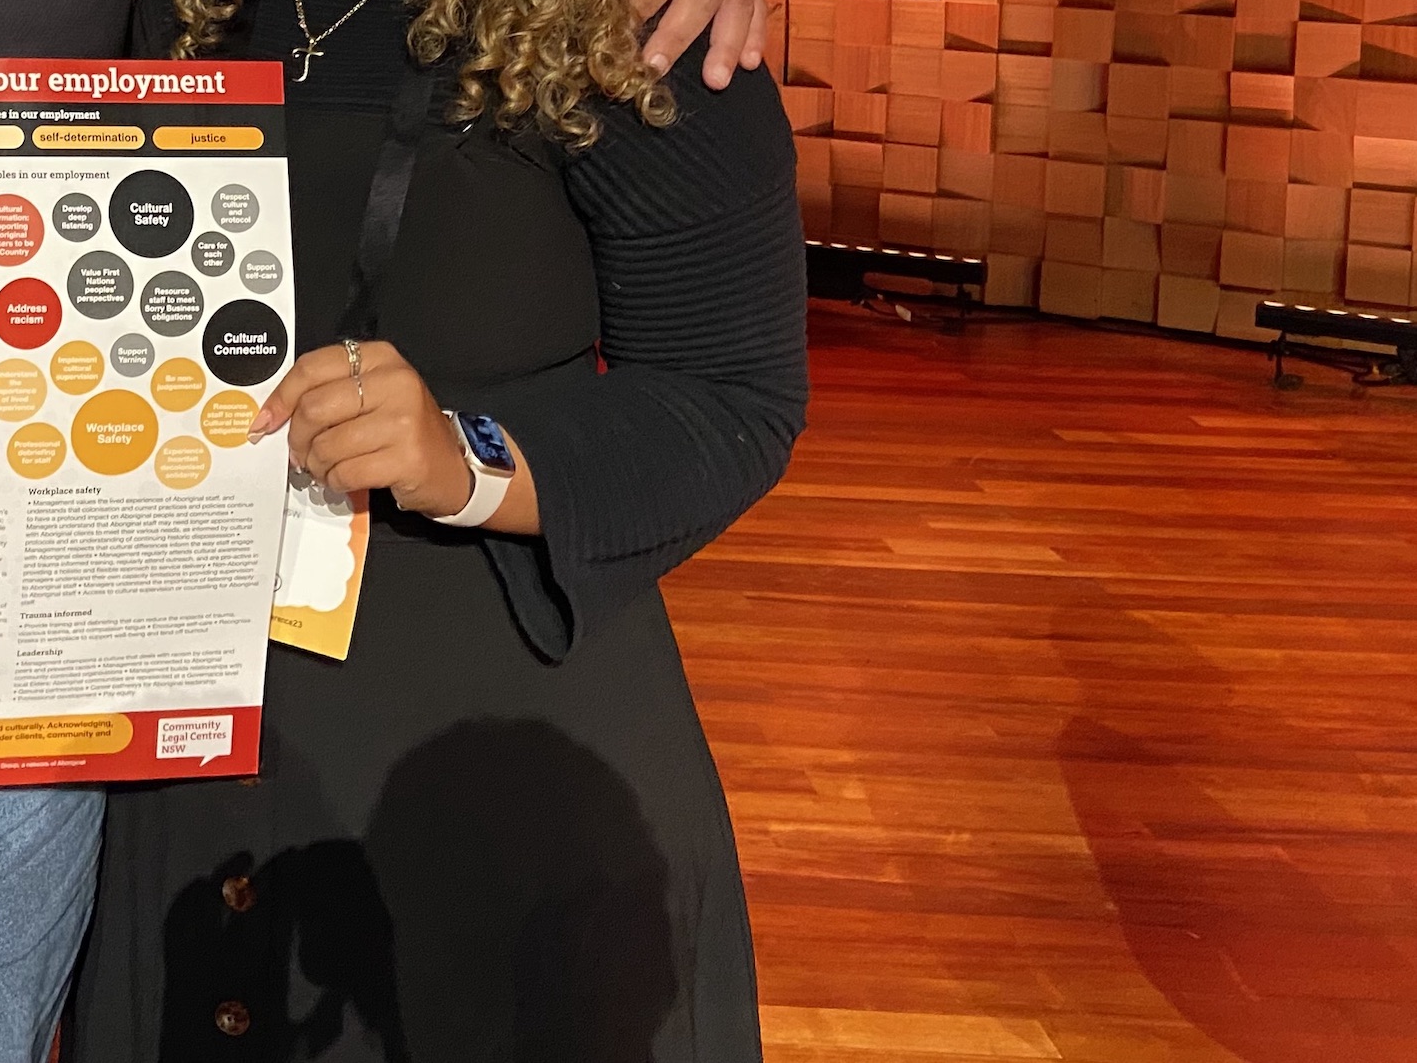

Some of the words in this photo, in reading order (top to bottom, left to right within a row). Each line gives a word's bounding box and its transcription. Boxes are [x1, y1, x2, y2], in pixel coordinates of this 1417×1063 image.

[48, 68, 225, 99] employment
[9, 109, 19, 119] in
[21, 111, 37, 119] our
[40, 110, 100, 121] employment
[40, 133, 138, 142] self-determination
[191, 133, 226, 144] justice
[19, 171, 28, 179] in
[50, 171, 110, 181] employment
[220, 193, 250, 202] Respect
[62, 205, 92, 213] Develop
[130, 203, 173, 213] Cultural
[68, 214, 86, 222] deep
[135, 215, 169, 227] Safety
[221, 216, 251, 225] protocol
[61, 222, 93, 231] listening
[0, 249, 29, 257] Country
[247, 264, 275, 272] Support
[81, 269, 101, 277] Value
[86, 277, 115, 285] Nations
[85, 286, 116, 295] peoples'
[77, 295, 124, 303] perspectives
[176, 296, 195, 304] meet
[7, 304, 47, 313] Address
[145, 305, 164, 313] Sorry
[167, 304, 200, 313] Business
[10, 316, 43, 324] racism
[152, 313, 192, 321] obligations
[224, 333, 267, 344] Cultural
[118, 347, 148, 356] Support
[214, 345, 276, 355] Connection
[119, 356, 146, 364] Yarning
[86, 423, 144, 434] Workplace
[97, 434, 132, 445] Safety
[29, 487, 73, 496] Workplace
[76, 486, 102, 495] safety
[20, 611, 52, 619] Trauma
[54, 609, 92, 617] informed
[17, 649, 63, 657] Leadership
[5, 722, 44, 731] culturally.
[47, 720, 114, 730] Acknowledging,
[162, 721, 221, 732] Community
[15, 732, 44, 741] clients,
[46, 730, 94, 739] community
[96, 729, 111, 737] and
[162, 733, 188, 743] Legal
[190, 731, 227, 741] Centres
[161, 745, 186, 754] NSW
